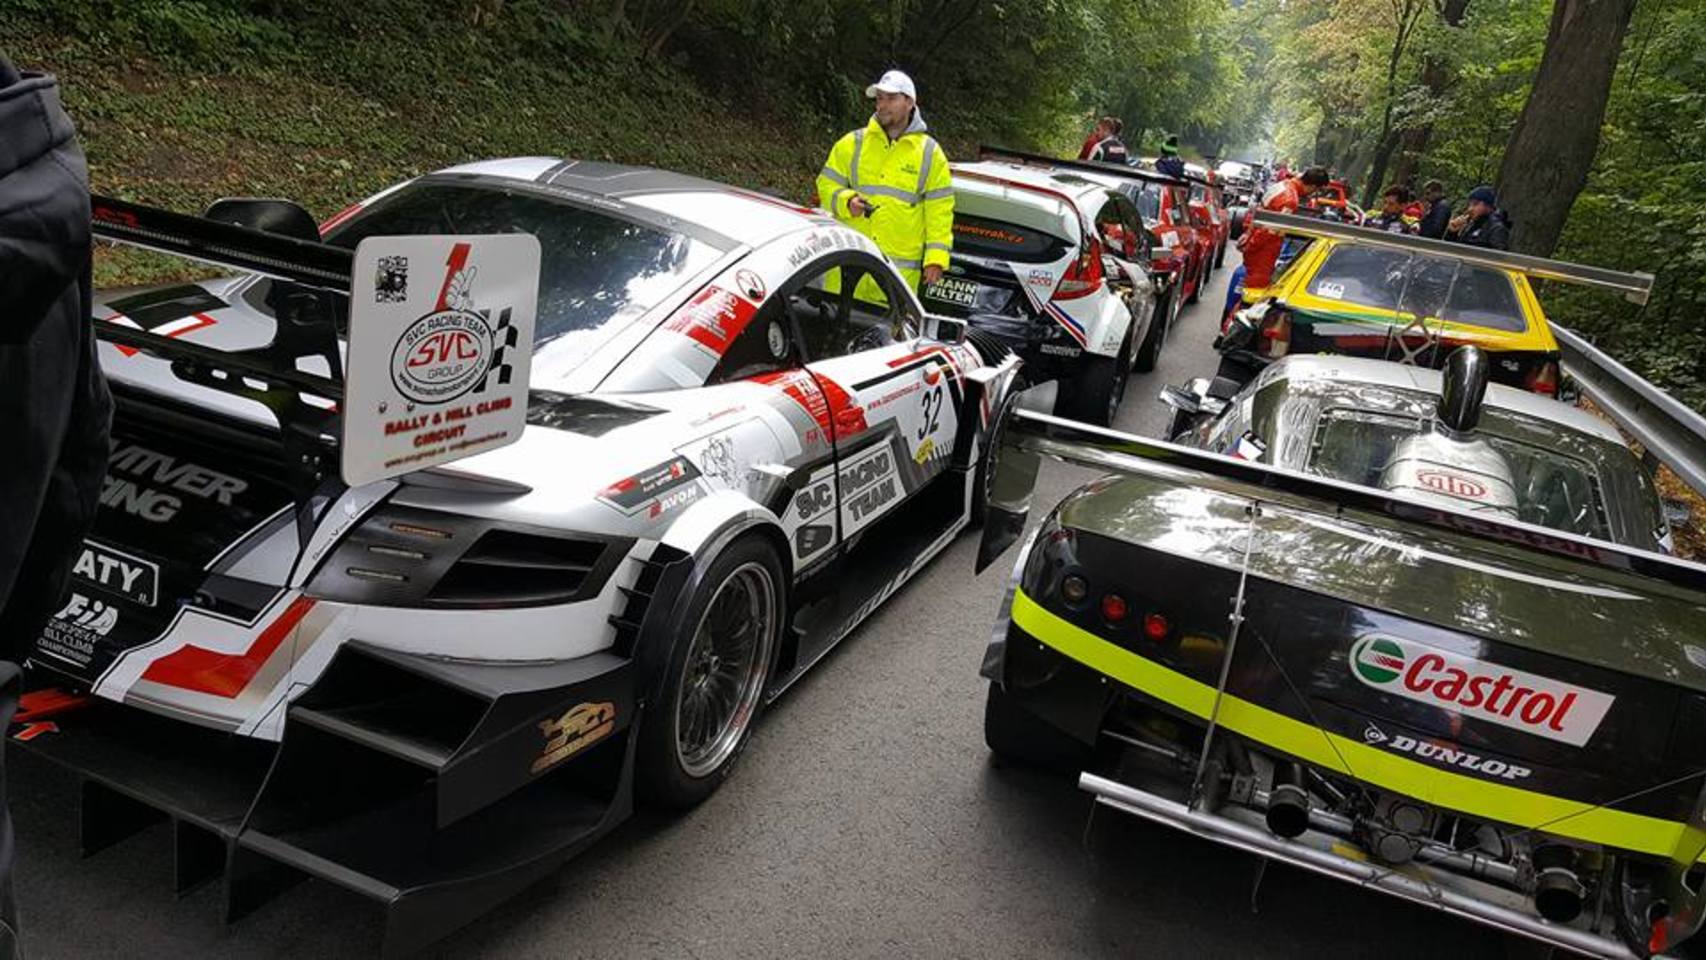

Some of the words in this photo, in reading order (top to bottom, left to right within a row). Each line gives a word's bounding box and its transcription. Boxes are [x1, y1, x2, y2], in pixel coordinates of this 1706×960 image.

[929, 287, 974, 305] FILTER
[406, 324, 426, 346] SVC
[427, 315, 463, 332] RACING
[463, 316, 487, 338] TEAM
[408, 332, 478, 368] SVC
[427, 363, 463, 380] GROUP
[384, 415, 429, 436] RALLY
[917, 386, 943, 440] 32
[413, 424, 468, 448] CIRCUIT
[99, 474, 183, 522] ING
[661, 485, 697, 511] AVON
[795, 483, 832, 520] SVC
[840, 452, 890, 501] RACING
[847, 477, 897, 522] TEAM
[72, 549, 144, 593] ATY
[1404, 653, 1578, 732] Castrol
[1387, 735, 1533, 781] DUNLOP
